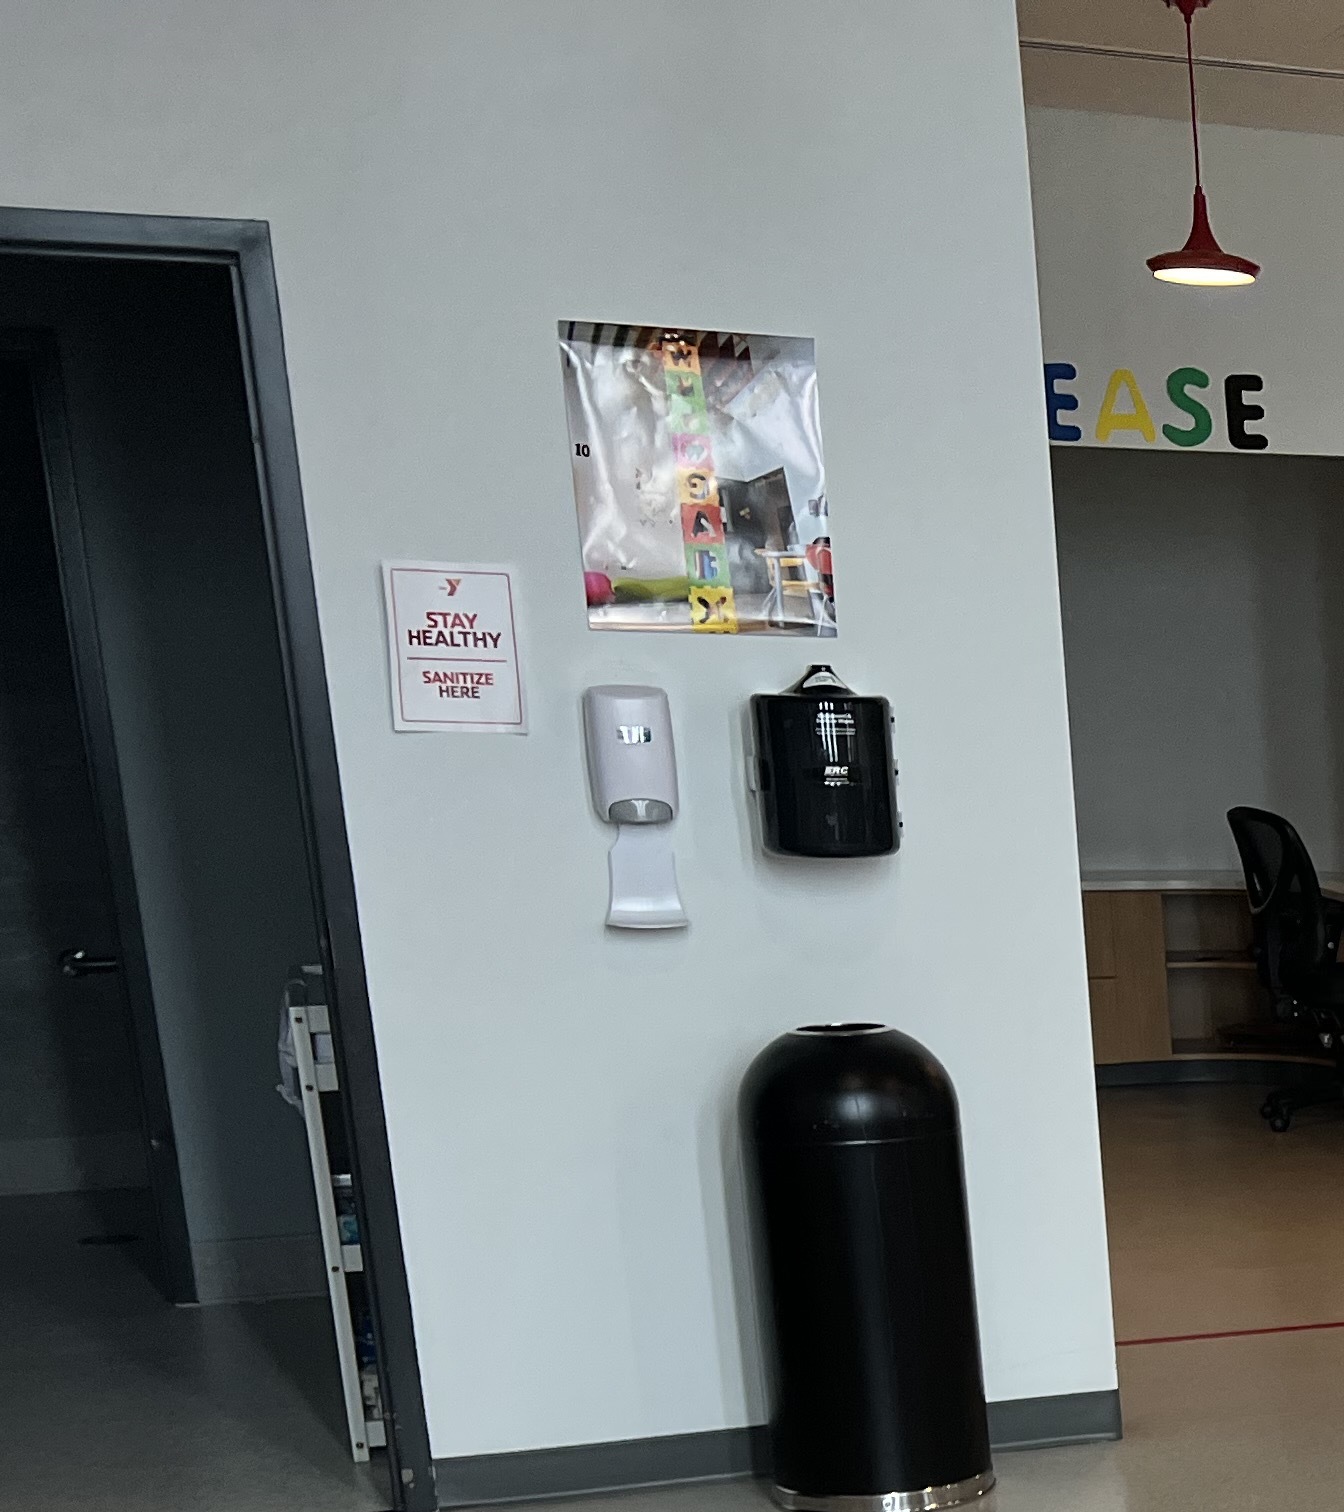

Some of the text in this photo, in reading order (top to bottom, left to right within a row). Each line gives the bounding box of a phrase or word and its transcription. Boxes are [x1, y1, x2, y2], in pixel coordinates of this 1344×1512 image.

[1044, 362, 1269, 450] EASE
[574, 443, 591, 458] 10
[426, 611, 478, 629] STAY
[407, 629, 502, 649] HEALTHY
[422, 671, 494, 686] SANITIZE
[438, 685, 481, 699] HERE
